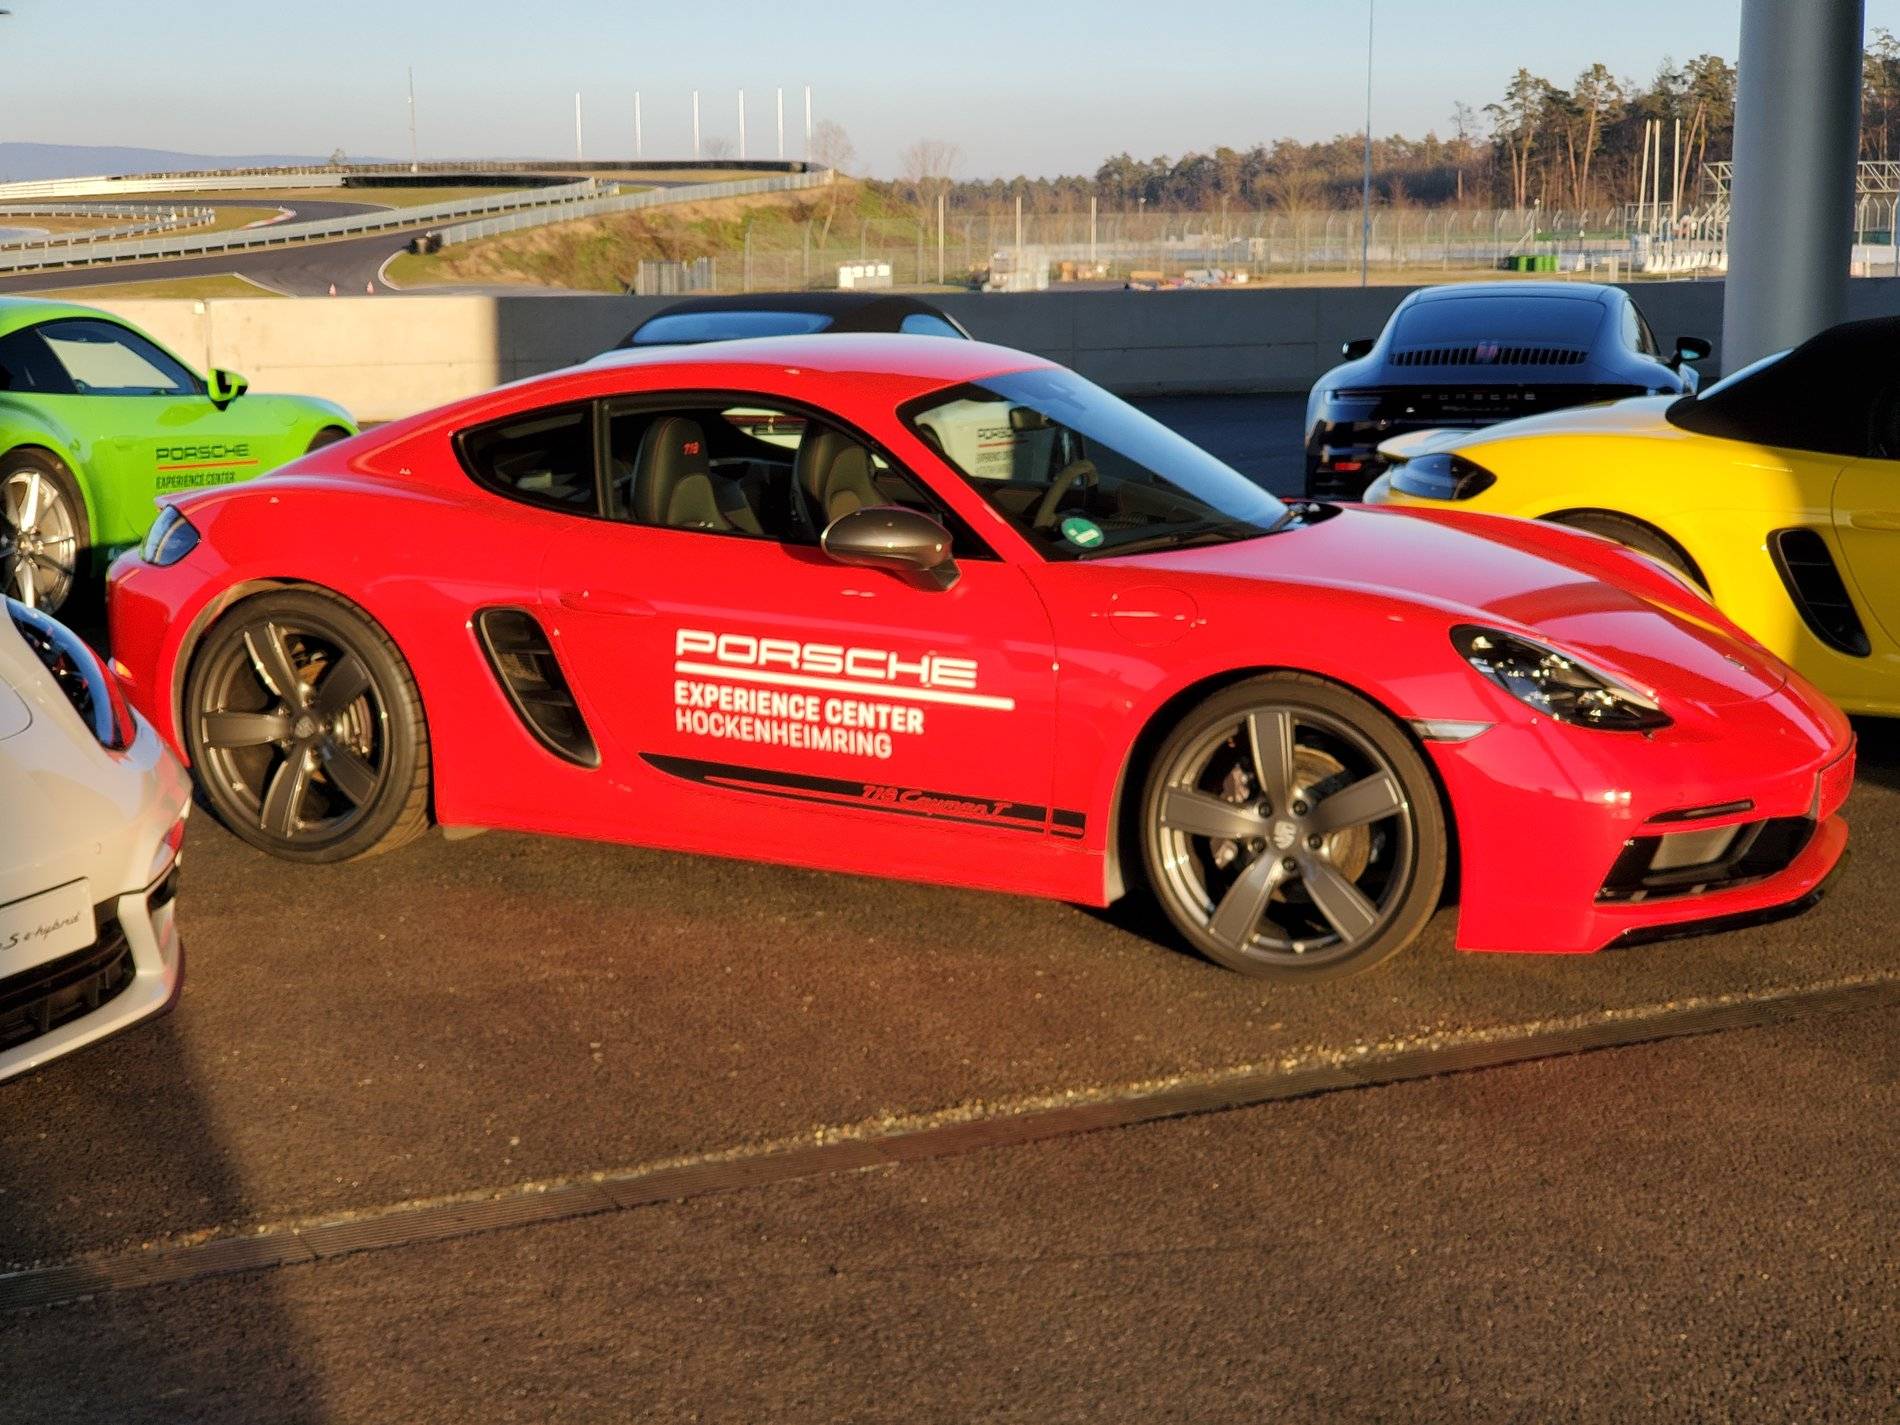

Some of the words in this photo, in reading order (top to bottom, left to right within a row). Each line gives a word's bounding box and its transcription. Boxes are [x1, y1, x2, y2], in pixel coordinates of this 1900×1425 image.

[155, 443, 249, 461] PORSCHE
[675, 628, 979, 690] PORSCHE
[674, 679, 821, 723] EXPERIENCE
[824, 697, 925, 736] CENTER
[675, 706, 893, 760] HOCKENHEIMRING
[862, 784, 899, 801] 718
